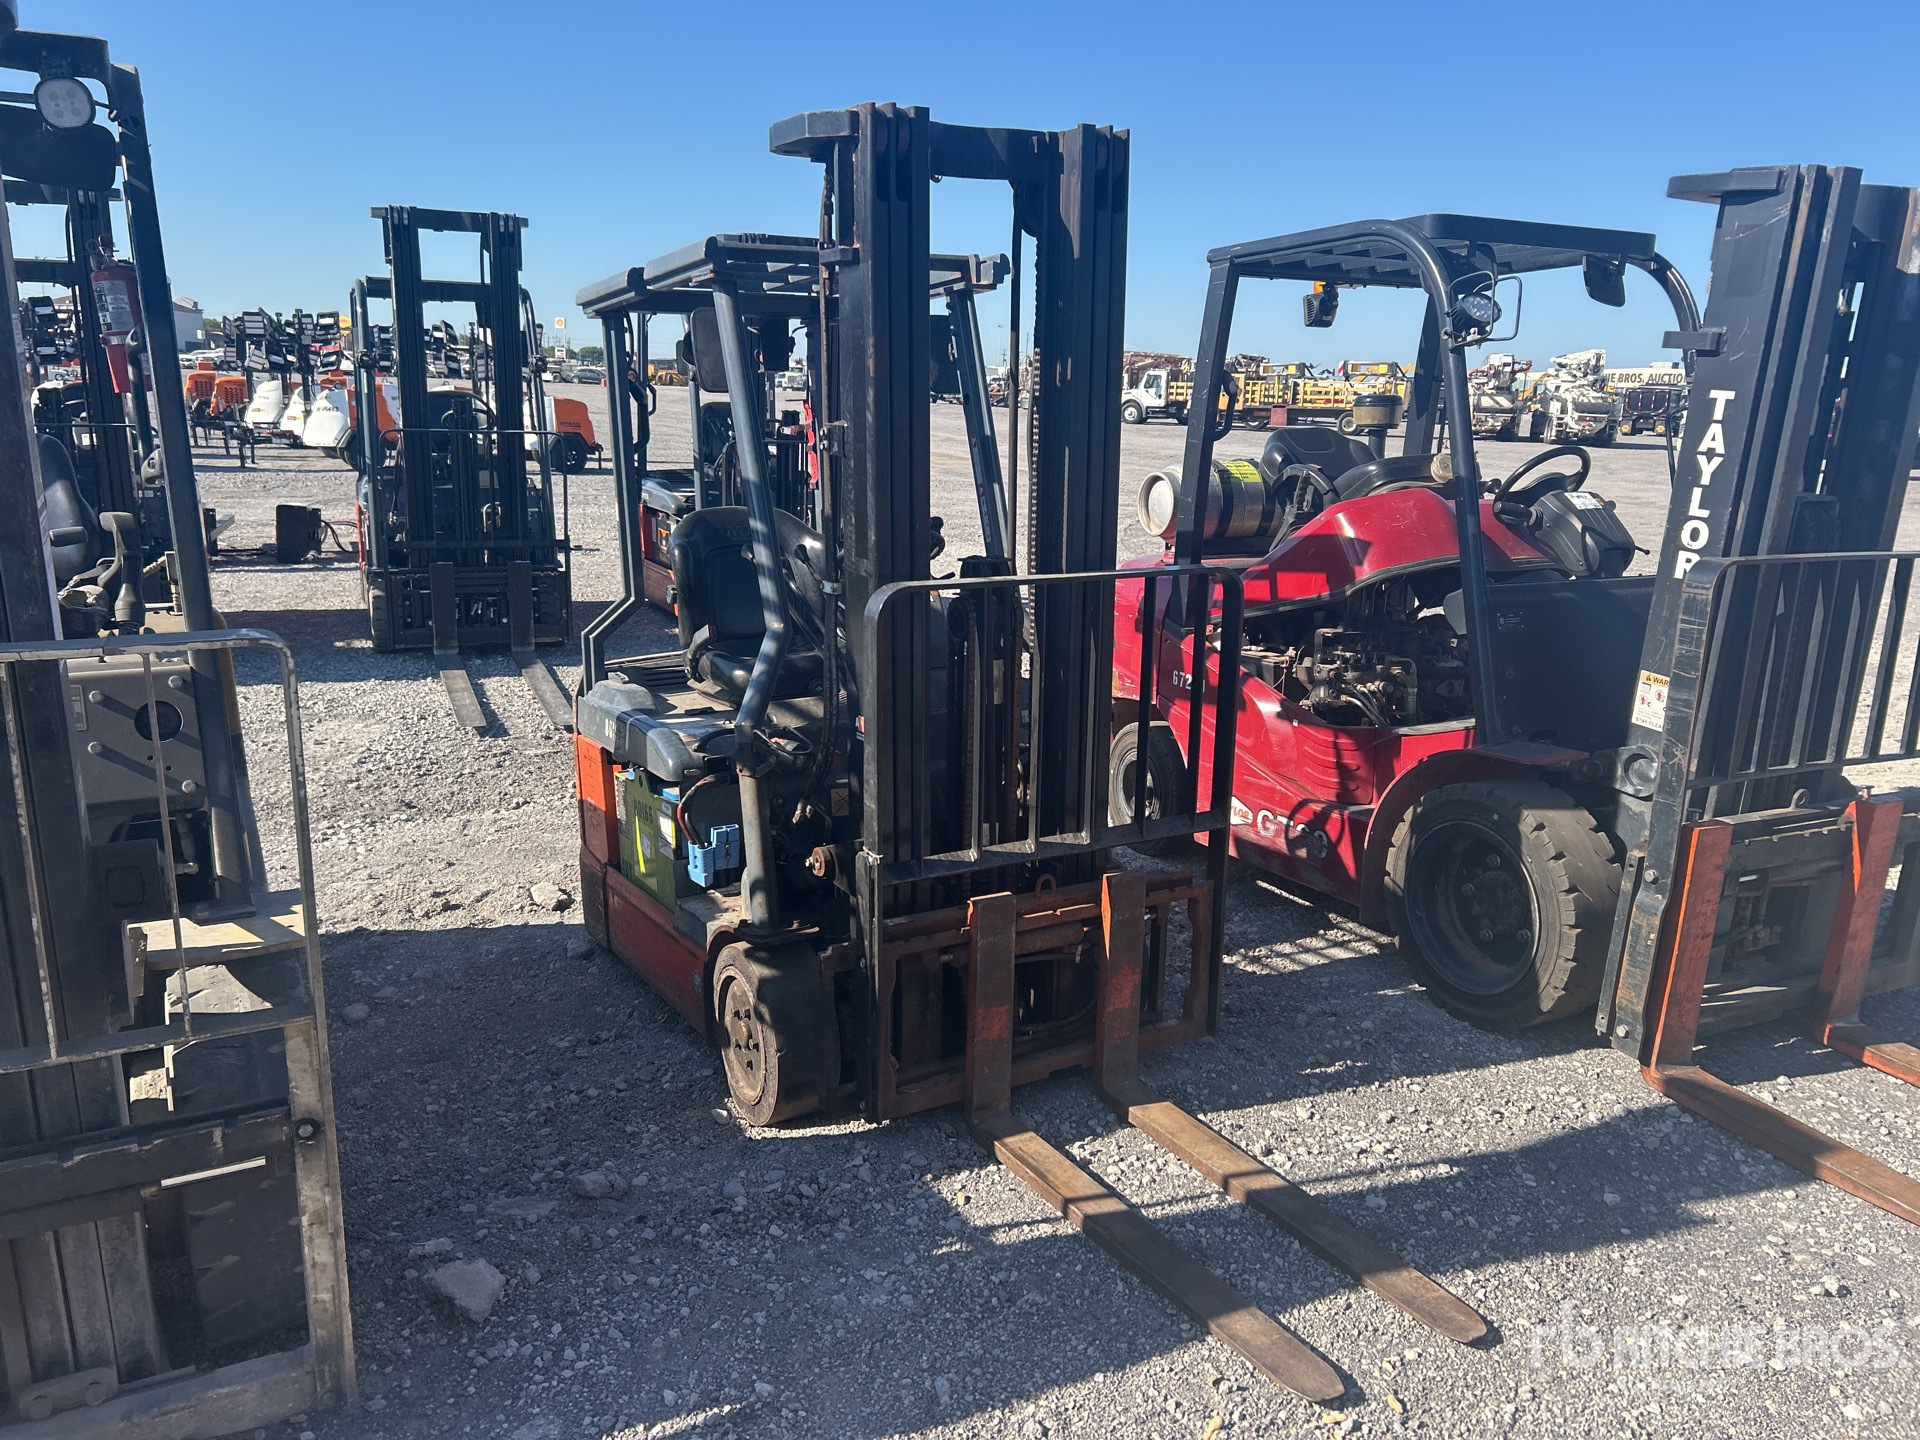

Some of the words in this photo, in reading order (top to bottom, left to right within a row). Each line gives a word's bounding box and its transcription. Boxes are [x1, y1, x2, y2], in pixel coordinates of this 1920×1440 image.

[1618, 373, 1645, 384] BROS.
[1648, 373, 1686, 384] AUCTIO
[1653, 676, 1670, 687] WAR
[1648, 721, 1662, 730] CLEA
